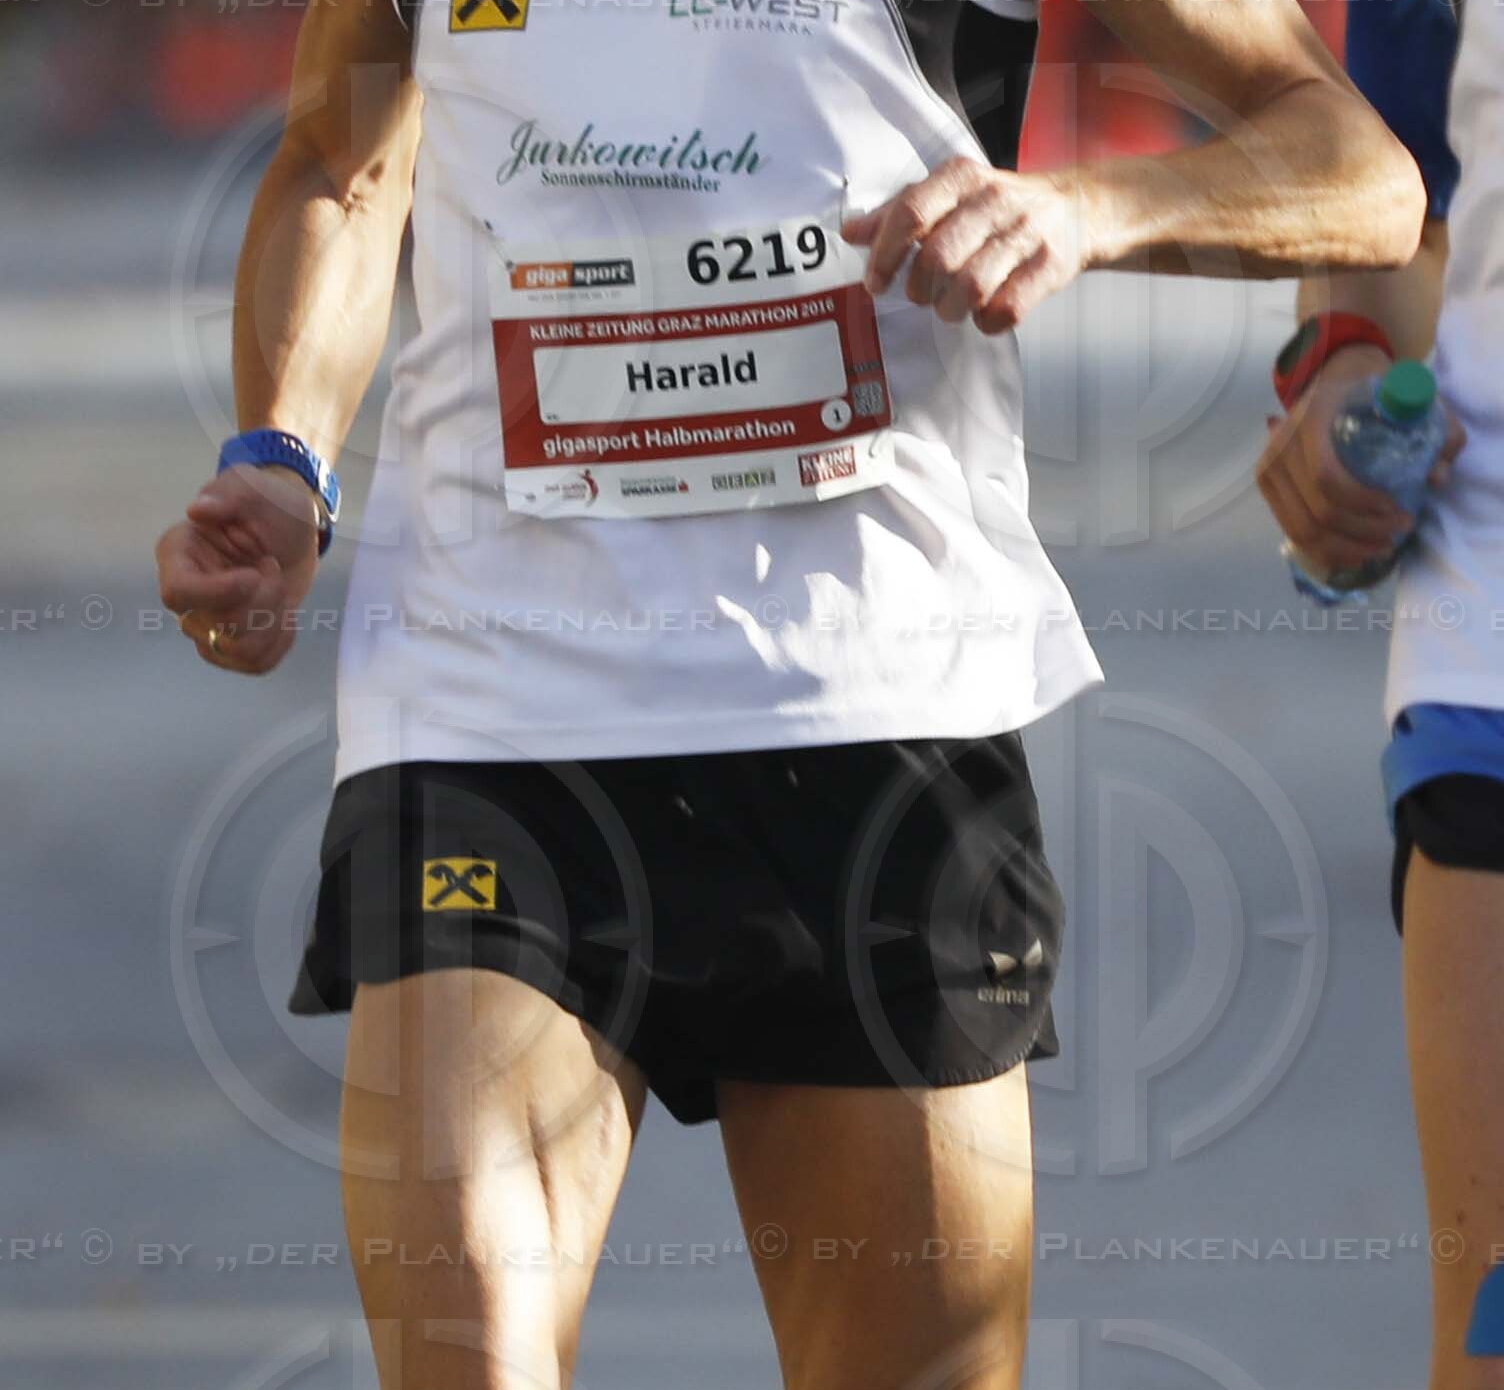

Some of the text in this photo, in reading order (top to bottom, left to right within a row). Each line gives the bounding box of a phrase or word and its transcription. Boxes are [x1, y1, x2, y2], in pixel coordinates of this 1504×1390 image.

[496, 119, 771, 186] Jurkowitsch
[541, 169, 721, 193] Sonnenschirmständer
[686, 225, 827, 286] 6219
[529, 323, 584, 340] KLEINE
[587, 320, 655, 338] ZEITUNG
[658, 318, 703, 334] GRAZ
[704, 305, 799, 329] MARATHON
[626, 350, 758, 393] Harald
[543, 419, 796, 459] gigasport Halbmarathon
